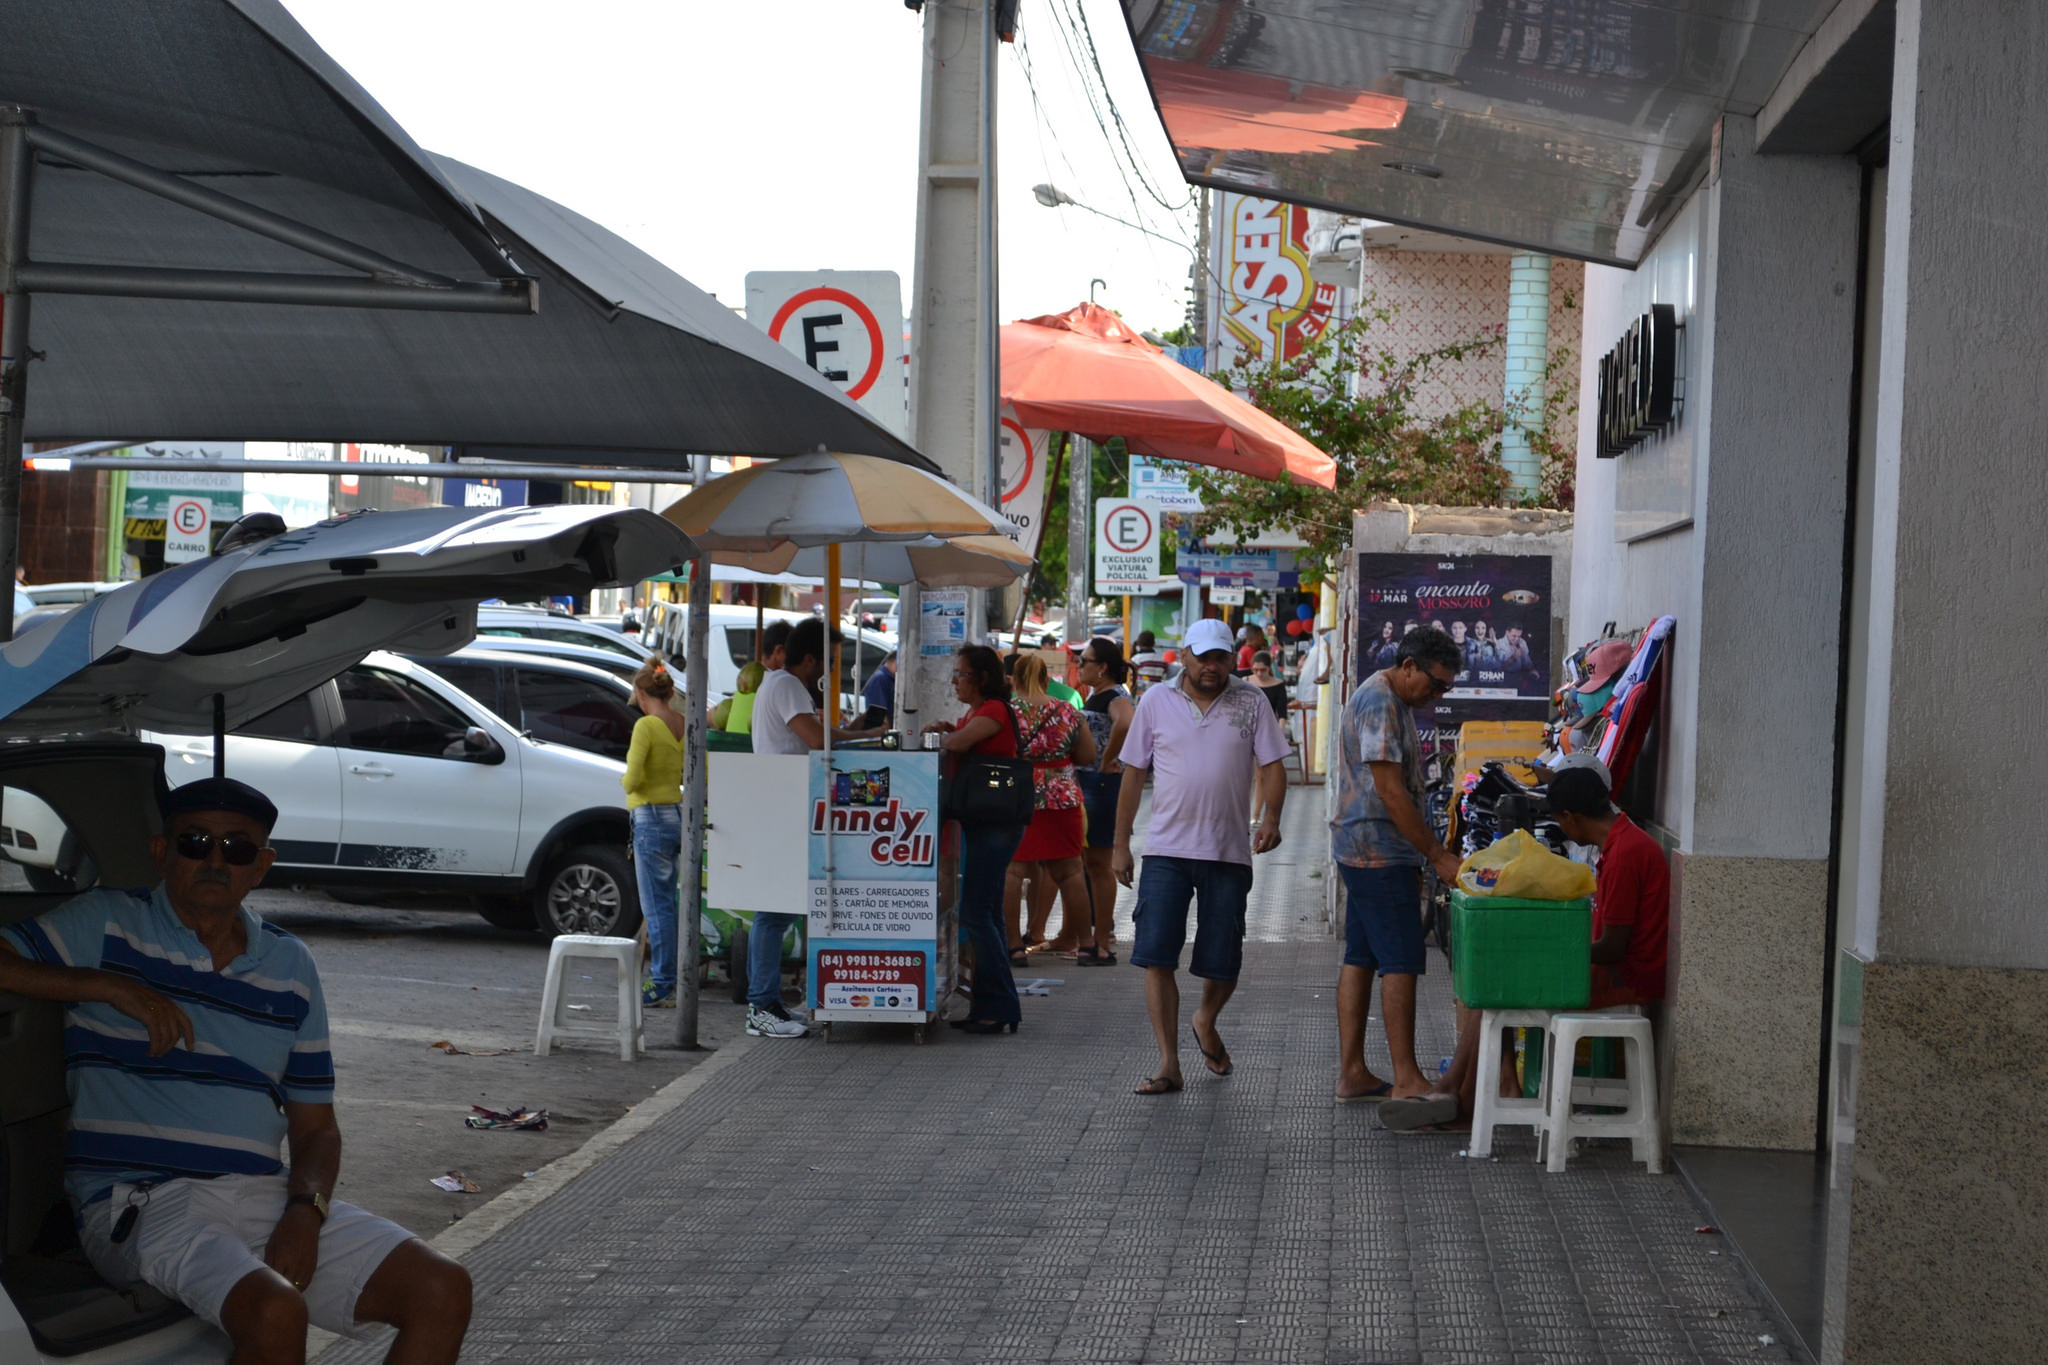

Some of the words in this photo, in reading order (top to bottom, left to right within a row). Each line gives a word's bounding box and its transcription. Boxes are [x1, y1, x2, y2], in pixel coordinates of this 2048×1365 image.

[802, 314, 848, 381] E
[183, 508, 196, 527] E
[1119, 517, 1138, 543] E
[168, 542, 206, 553] CARRO
[1187, 539, 1270, 556] ANBOM
[1102, 556, 1153, 564] EXCLUSIVO
[1106, 572, 1149, 580] POLICIAL
[1108, 585, 1134, 593] FINAL
[1415, 580, 1493, 598] encanta
[812, 798, 928, 842] Inndy
[870, 833, 933, 864] Cell
[814, 887, 860, 896] CELARES
[866, 887, 930, 897] CARREGADORES
[815, 899, 839, 907] CHS
[845, 897, 876, 908] CARTÃO
[878, 899, 889, 908] DE
[891, 898, 929, 909] MEMÓRIA
[811, 911, 827, 919] PEN
[860, 911, 886, 919] FONES
[888, 911, 899, 920] DE
[901, 912, 934, 921] OUVIDO
[833, 921, 871, 931] PELÍCULA
[873, 923, 884, 931] DE
[885, 923, 911, 932] VIDRO
[821, 955, 843, 967] (84)
[846, 955, 912, 966] 99818-3688
[833, 969, 900, 980] 99184-3789
